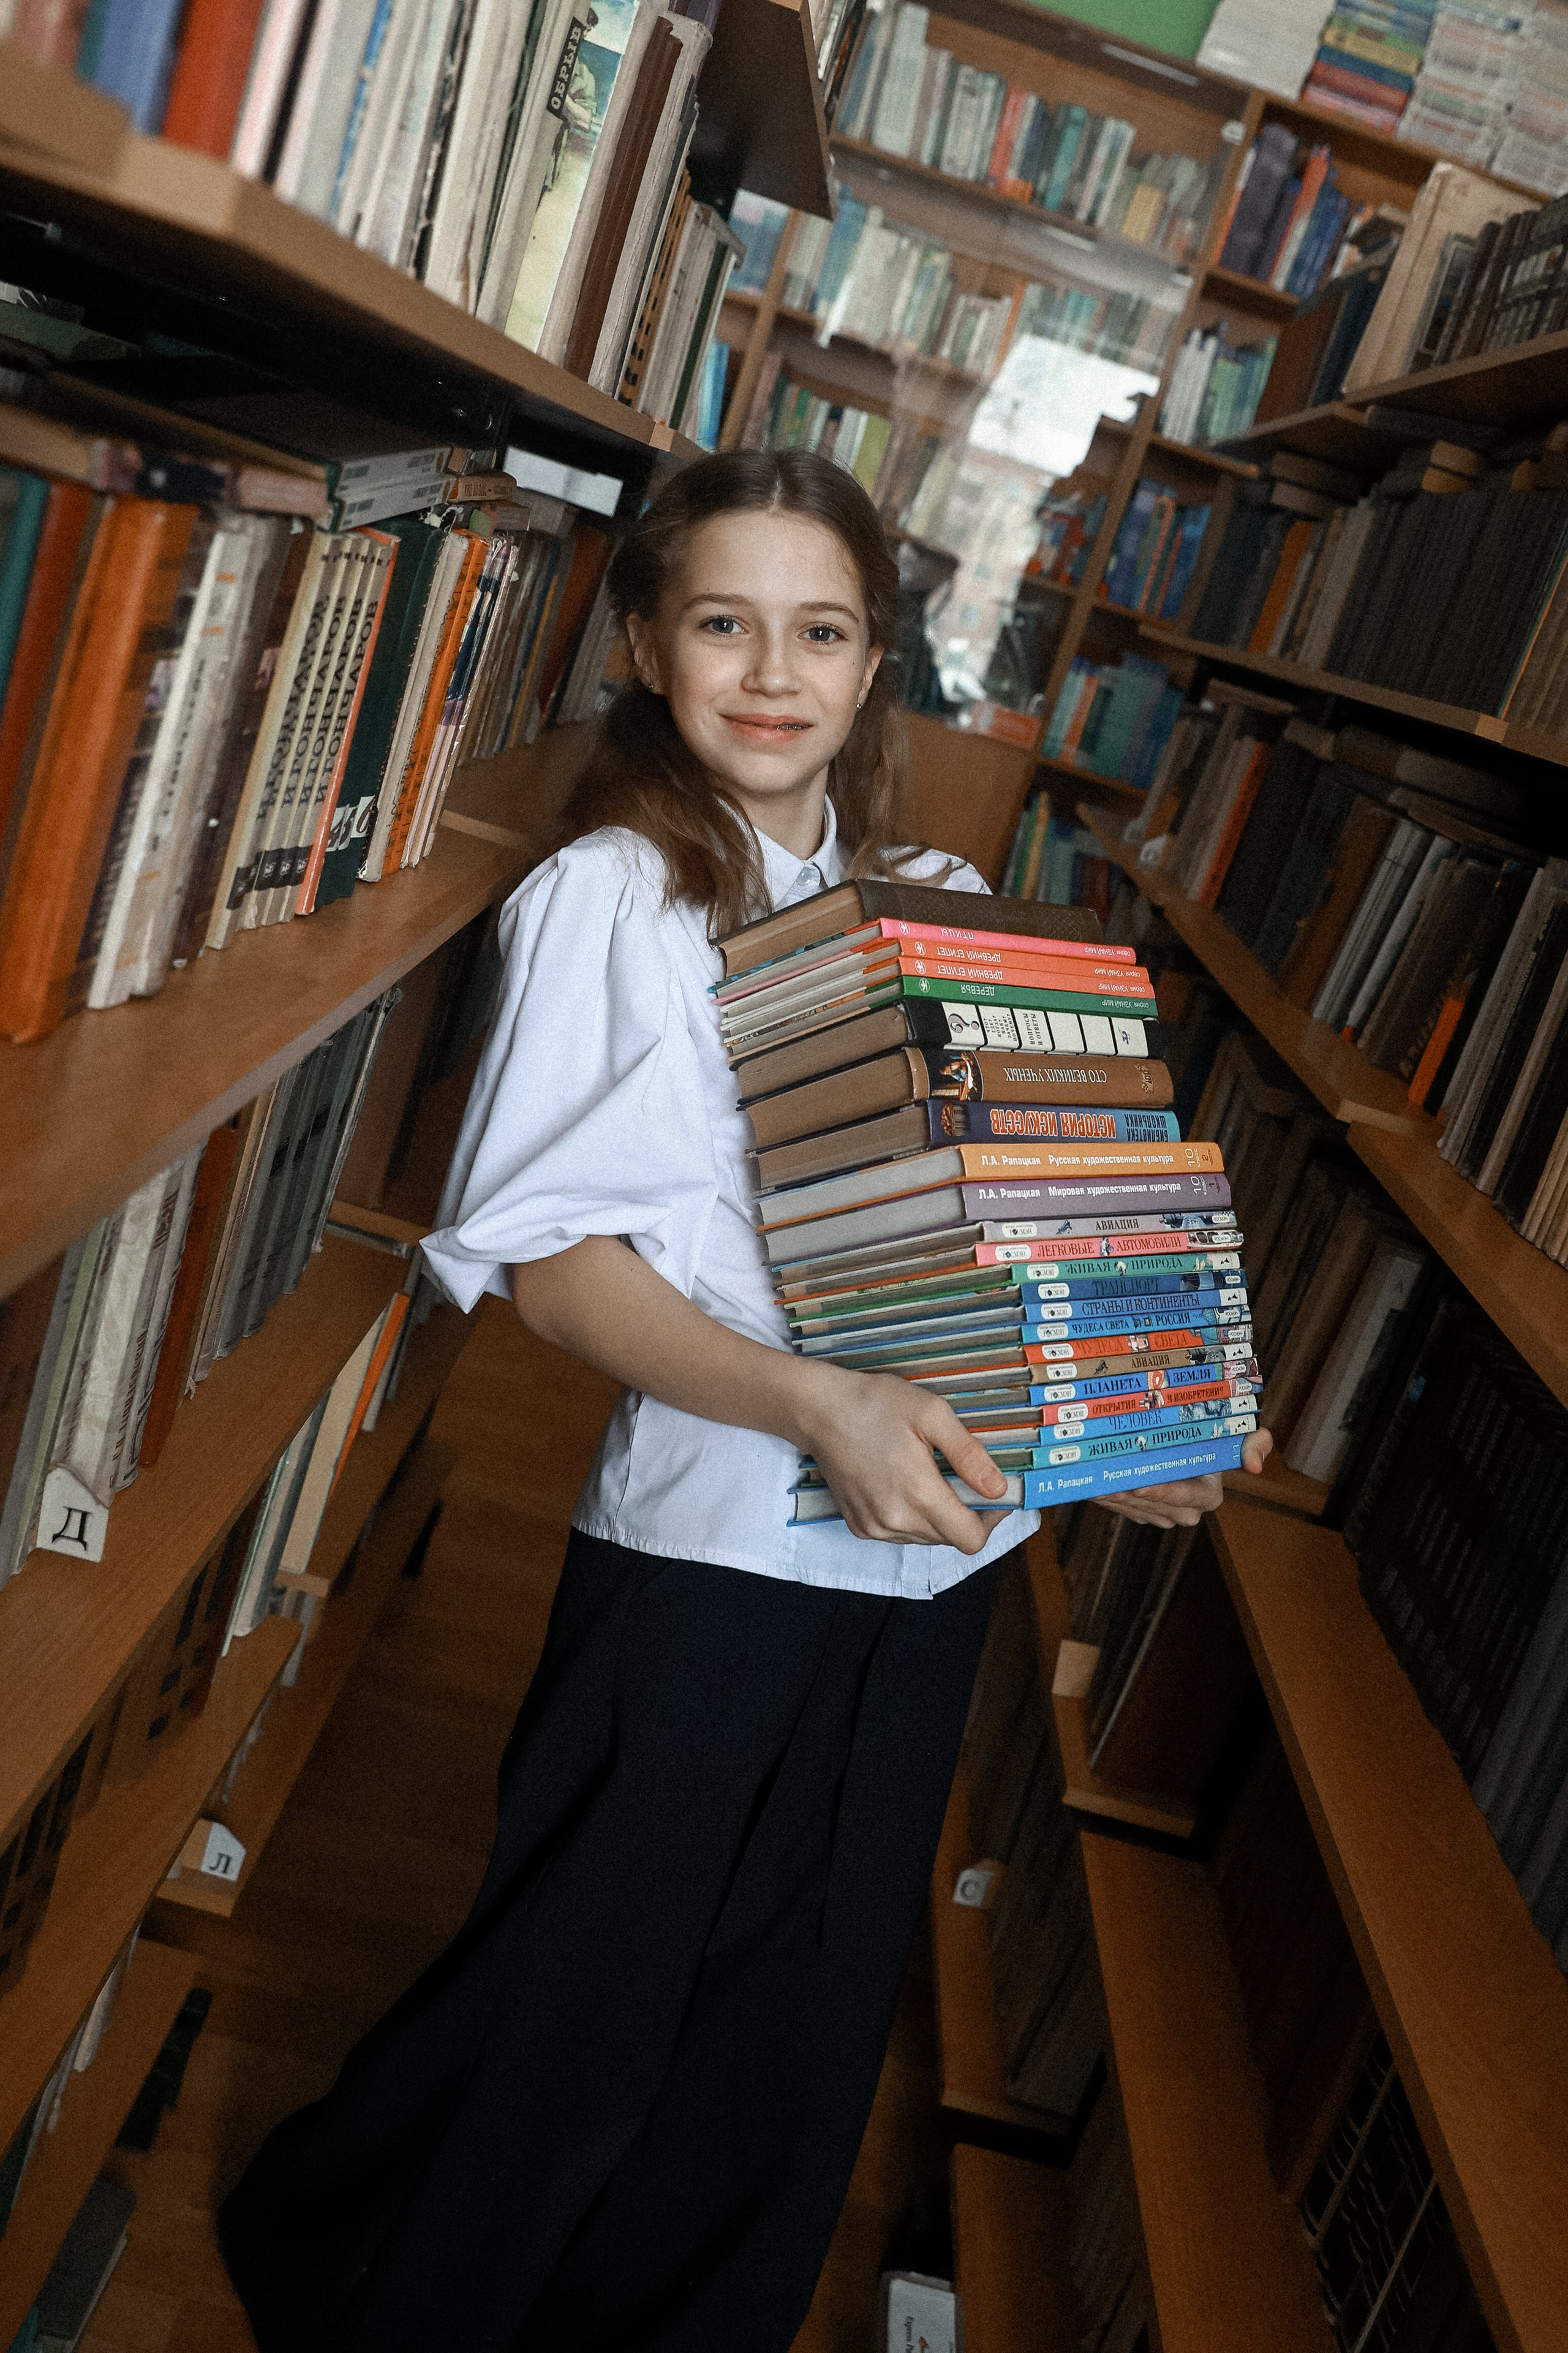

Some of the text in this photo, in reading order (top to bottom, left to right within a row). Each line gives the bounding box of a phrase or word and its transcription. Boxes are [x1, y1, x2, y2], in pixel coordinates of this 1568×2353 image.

[551, 26, 582, 110] ОБРЫВ
[940, 928, 974, 940] ПТИЦЫ
[937, 946, 965, 958] ЕГИПЕТ
[966, 950, 1001, 963] ДРЕВНИЙ
[1097, 947, 1115, 956] УЗНАЙ
[937, 964, 966, 976] ЕГИПЕТ
[968, 969, 1003, 980] ДРЕВНИЙ
[1107, 968, 1125, 978] УЗНАЙ
[960, 984, 995, 997] ДЕРЕВЬЯ
[1110, 983, 1129, 992] УЗНАЙ
[1115, 999, 1133, 1008] УЗНАЙ
[992, 1015, 1002, 1038] КОГДА?
[1003, 1016, 1012, 1039] ЗАЧЕМ?
[1007, 1014, 1017, 1041] ПОЧЕМУ?
[1022, 1013, 1036, 1045] ВОПРОСЫ
[1030, 1013, 1042, 1040] ОТВЕТЫ
[1003, 1067, 1107, 1083] СТО ВЕЛИКИХ УЧЕНЫХ
[990, 1109, 1116, 1139] ИСТОРИЯ ИСКУССТВ
[1124, 1113, 1167, 1128] ШКОЛЬНИКА
[1126, 1128, 1169, 1143] БИБЛИОТЕКА
[981, 1154, 1174, 1167] Л.А. Рапацкая Русская художественная культура
[1185, 1148, 1196, 1167] 10
[978, 1182, 1181, 1199] Л.А. Рапацкая Мировая художественная культура
[1190, 1176, 1202, 1195] 10
[1095, 1218, 1139, 1231] АВИАЦИЯ
[1037, 1236, 1182, 1257] ЛЕГКОВЫЕ АВТОМОБИЛИ
[1065, 1256, 1183, 1274] ЖИВАЯ ПРИРОДА
[1092, 1278, 1159, 1296] ТРАНСПОРТ
[1082, 1294, 1200, 1316] СТРАНЫ И КОНТИНЕНТЫ
[1071, 1312, 1191, 1334] ЧУДЕСА СВЕТА РОССИЯ
[1076, 1332, 1188, 1355] ЧУДЕСА СВЕТА
[1131, 1354, 1170, 1369] АВИАЦИЯ
[1084, 1368, 1212, 1395] ПЛАНЕТА ЗЕМЛЯ
[1092, 1399, 1136, 1415] ОТКРЫТИЯ
[1109, 1410, 1163, 1431] ЧЕЛОВЕК
[1088, 1427, 1202, 1456] ЖИВАЯ ПРИРОДА
[1232, 1444, 1240, 1461] 11
[1038, 1452, 1216, 1494] Л.А. Рапацкая Русская художественная культура
[51, 1506, 93, 1552] Д
[209, 1853, 232, 1874] Л
